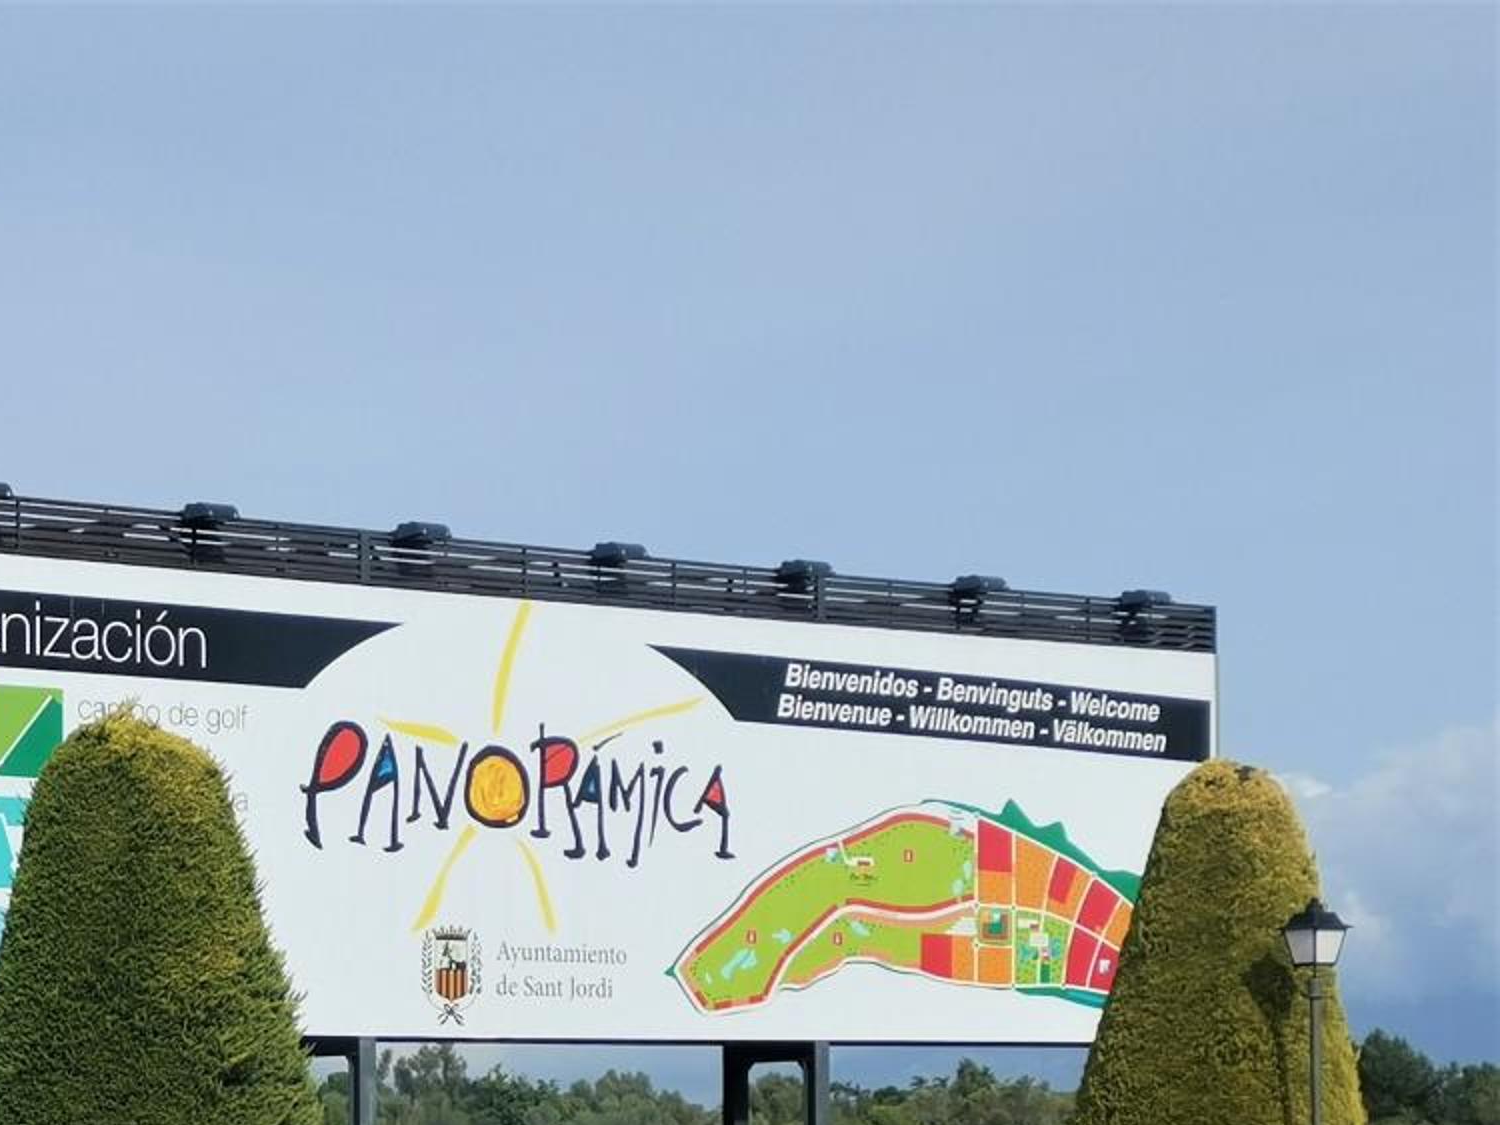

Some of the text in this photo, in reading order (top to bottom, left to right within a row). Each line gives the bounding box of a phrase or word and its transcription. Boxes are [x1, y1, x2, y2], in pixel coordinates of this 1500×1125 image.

[784, 662, 919, 698] Bienvenidos
[936, 677, 1053, 713] Benvinguts
[1070, 690, 1161, 722] Welcome
[77, 699, 248, 735] cao de golf
[777, 693, 892, 727] Bienvenue
[909, 705, 1035, 740] Willkommen
[1052, 718, 1167, 753] Välkommen
[496, 942, 628, 968] Ayuntamiento
[495, 974, 614, 1000] de Sant Jordi
